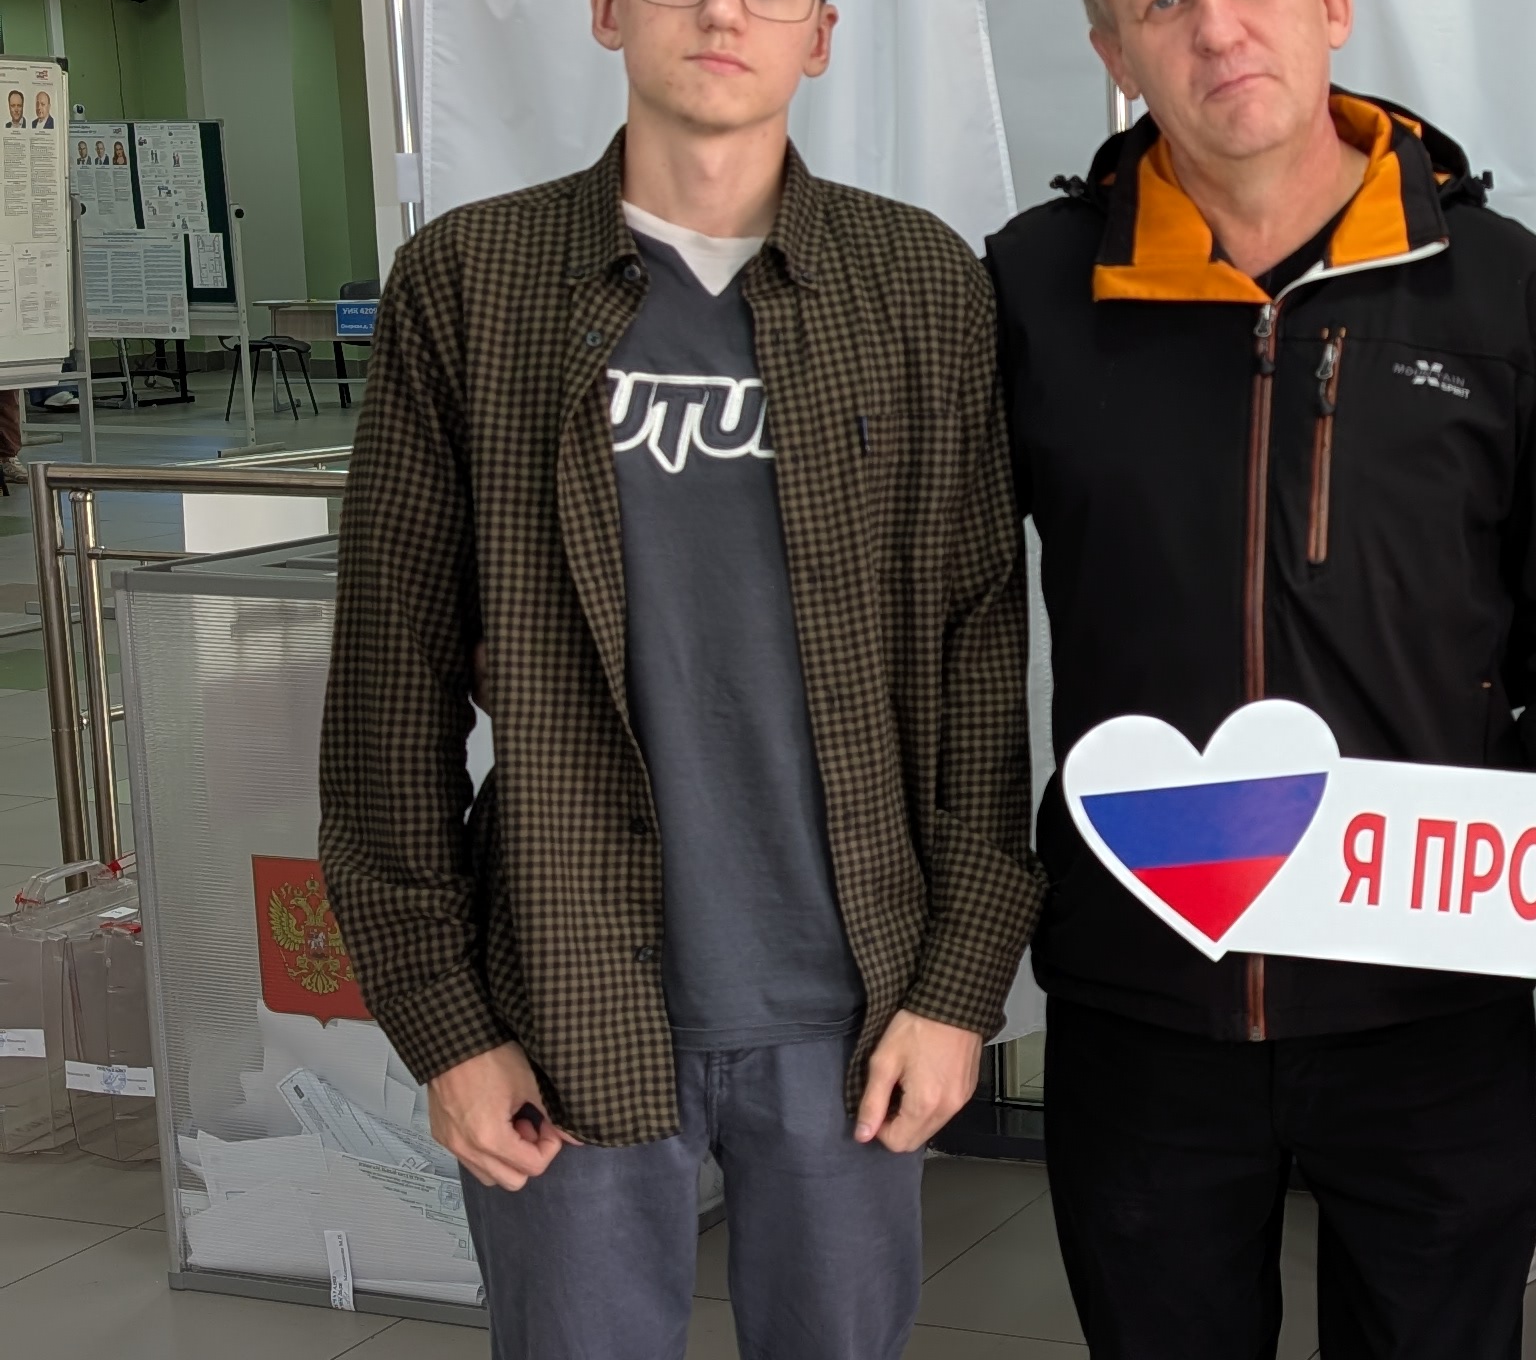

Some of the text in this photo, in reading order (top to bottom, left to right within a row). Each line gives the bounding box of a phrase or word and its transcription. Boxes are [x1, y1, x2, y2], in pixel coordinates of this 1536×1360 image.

[342, 307, 358, 315] УИК
[607, 369, 775, 474] UTU
[1339, 811, 1388, 907] Я
